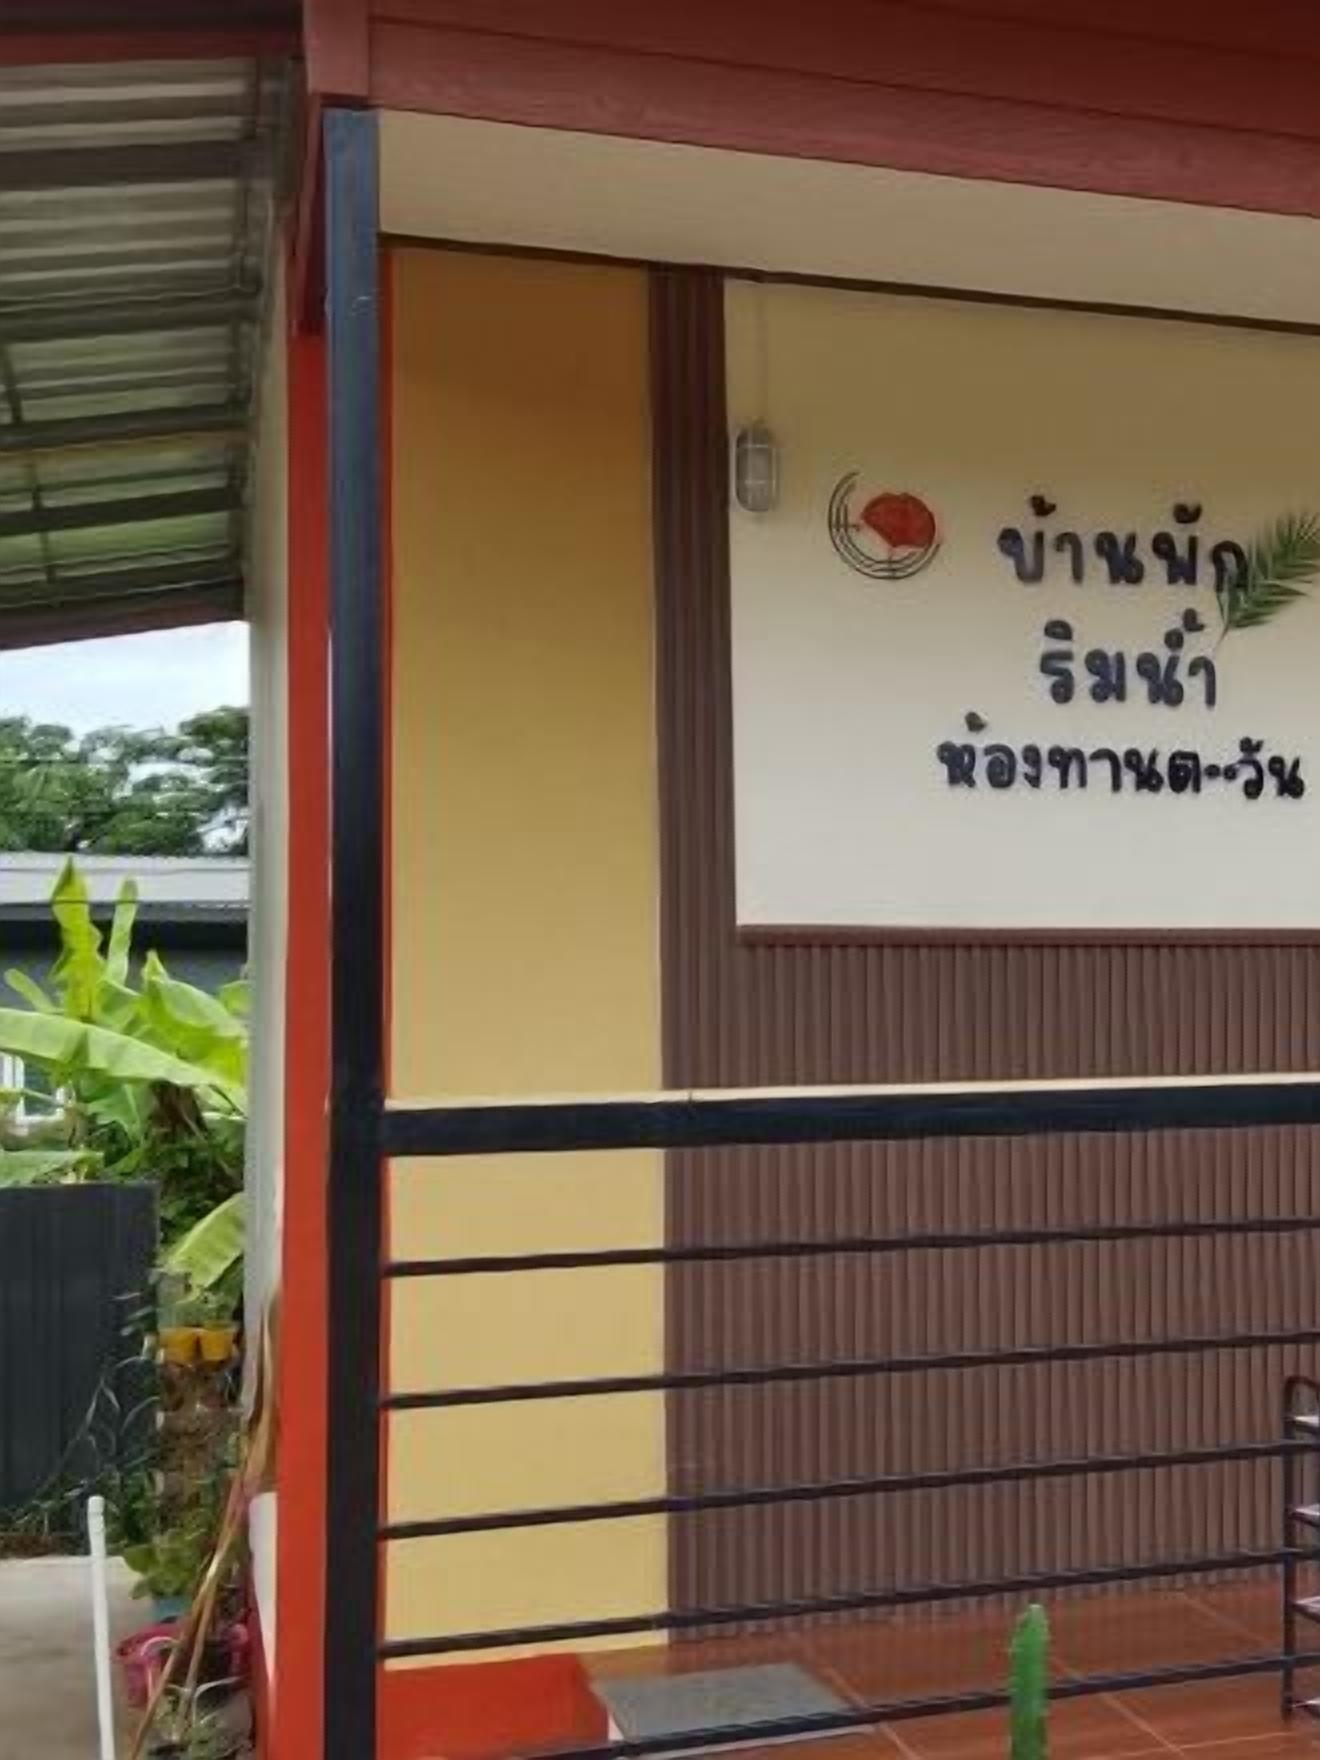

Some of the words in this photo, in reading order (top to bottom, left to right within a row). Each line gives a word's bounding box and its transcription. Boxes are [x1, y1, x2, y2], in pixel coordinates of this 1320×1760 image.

[997, 495, 1249, 593] บ้านพัก
[1040, 607, 1216, 710] ริมน้ำ
